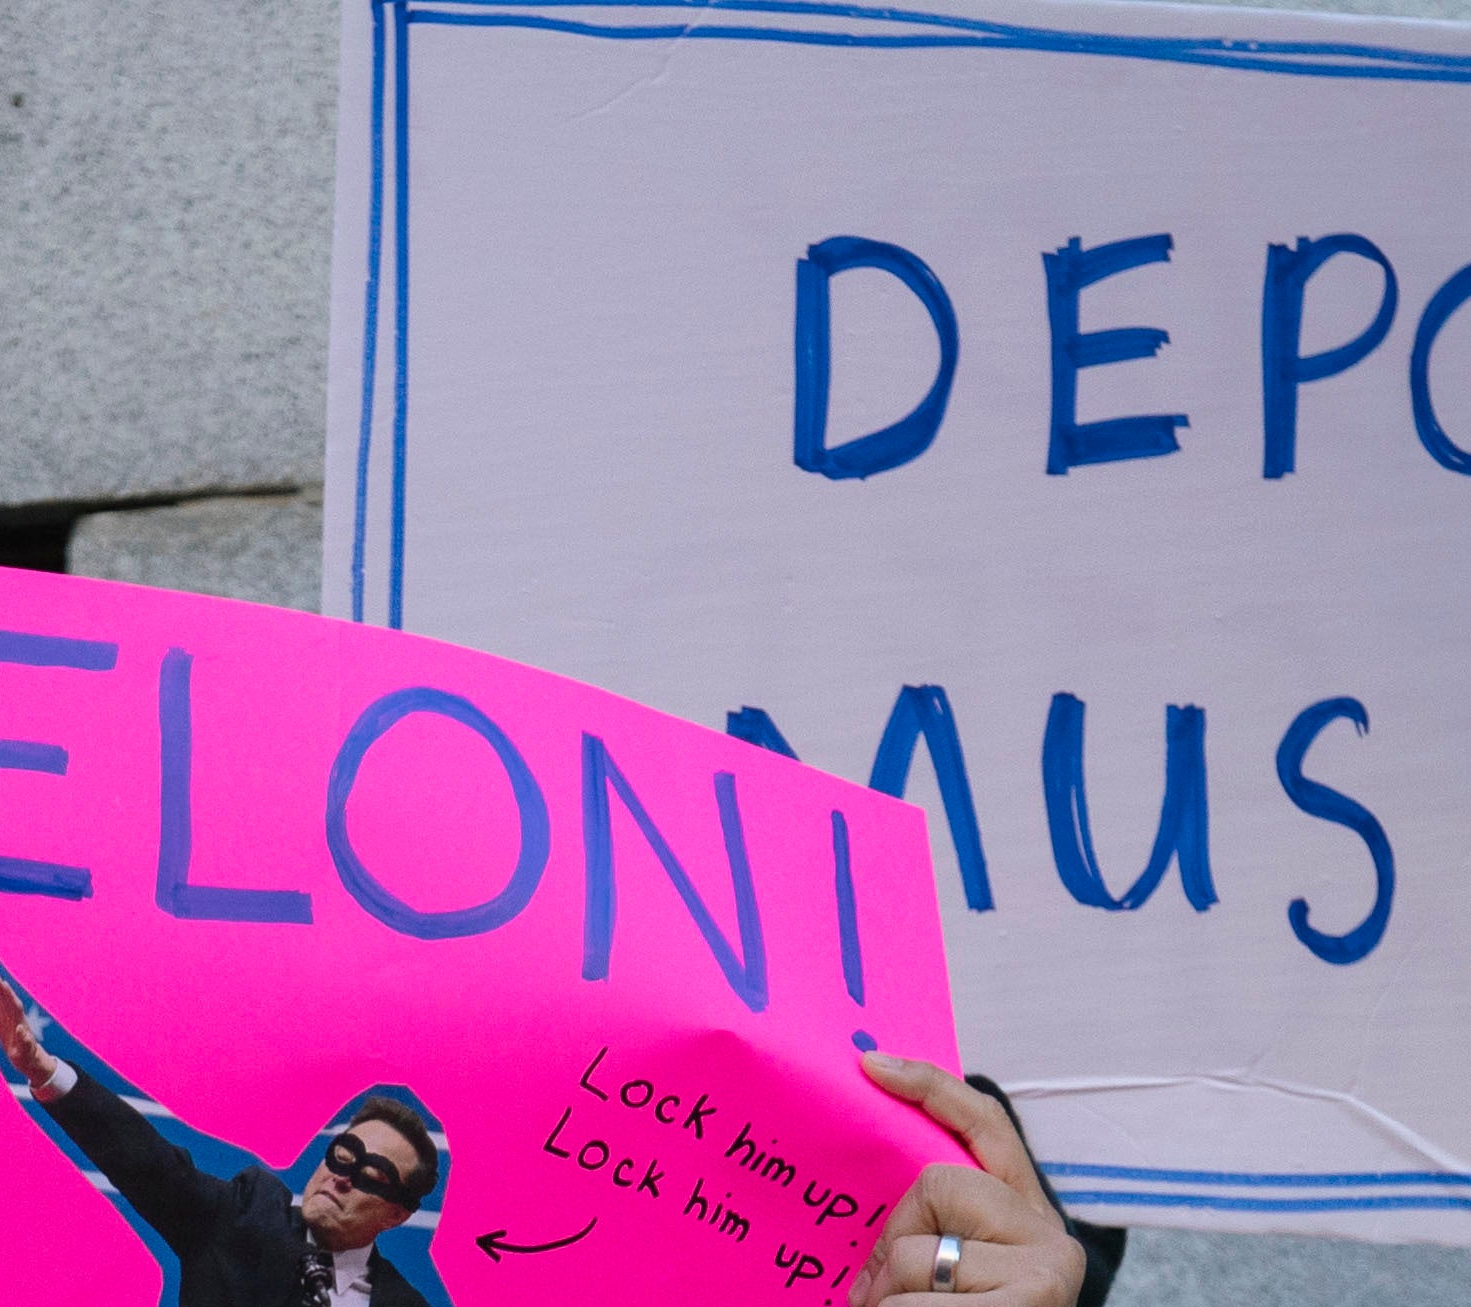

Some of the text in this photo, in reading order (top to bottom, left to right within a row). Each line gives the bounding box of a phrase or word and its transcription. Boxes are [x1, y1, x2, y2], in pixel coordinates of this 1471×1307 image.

[543, 1107, 850, 1306] Lock him up!
[580, 1047, 887, 1247] Lock him up!
